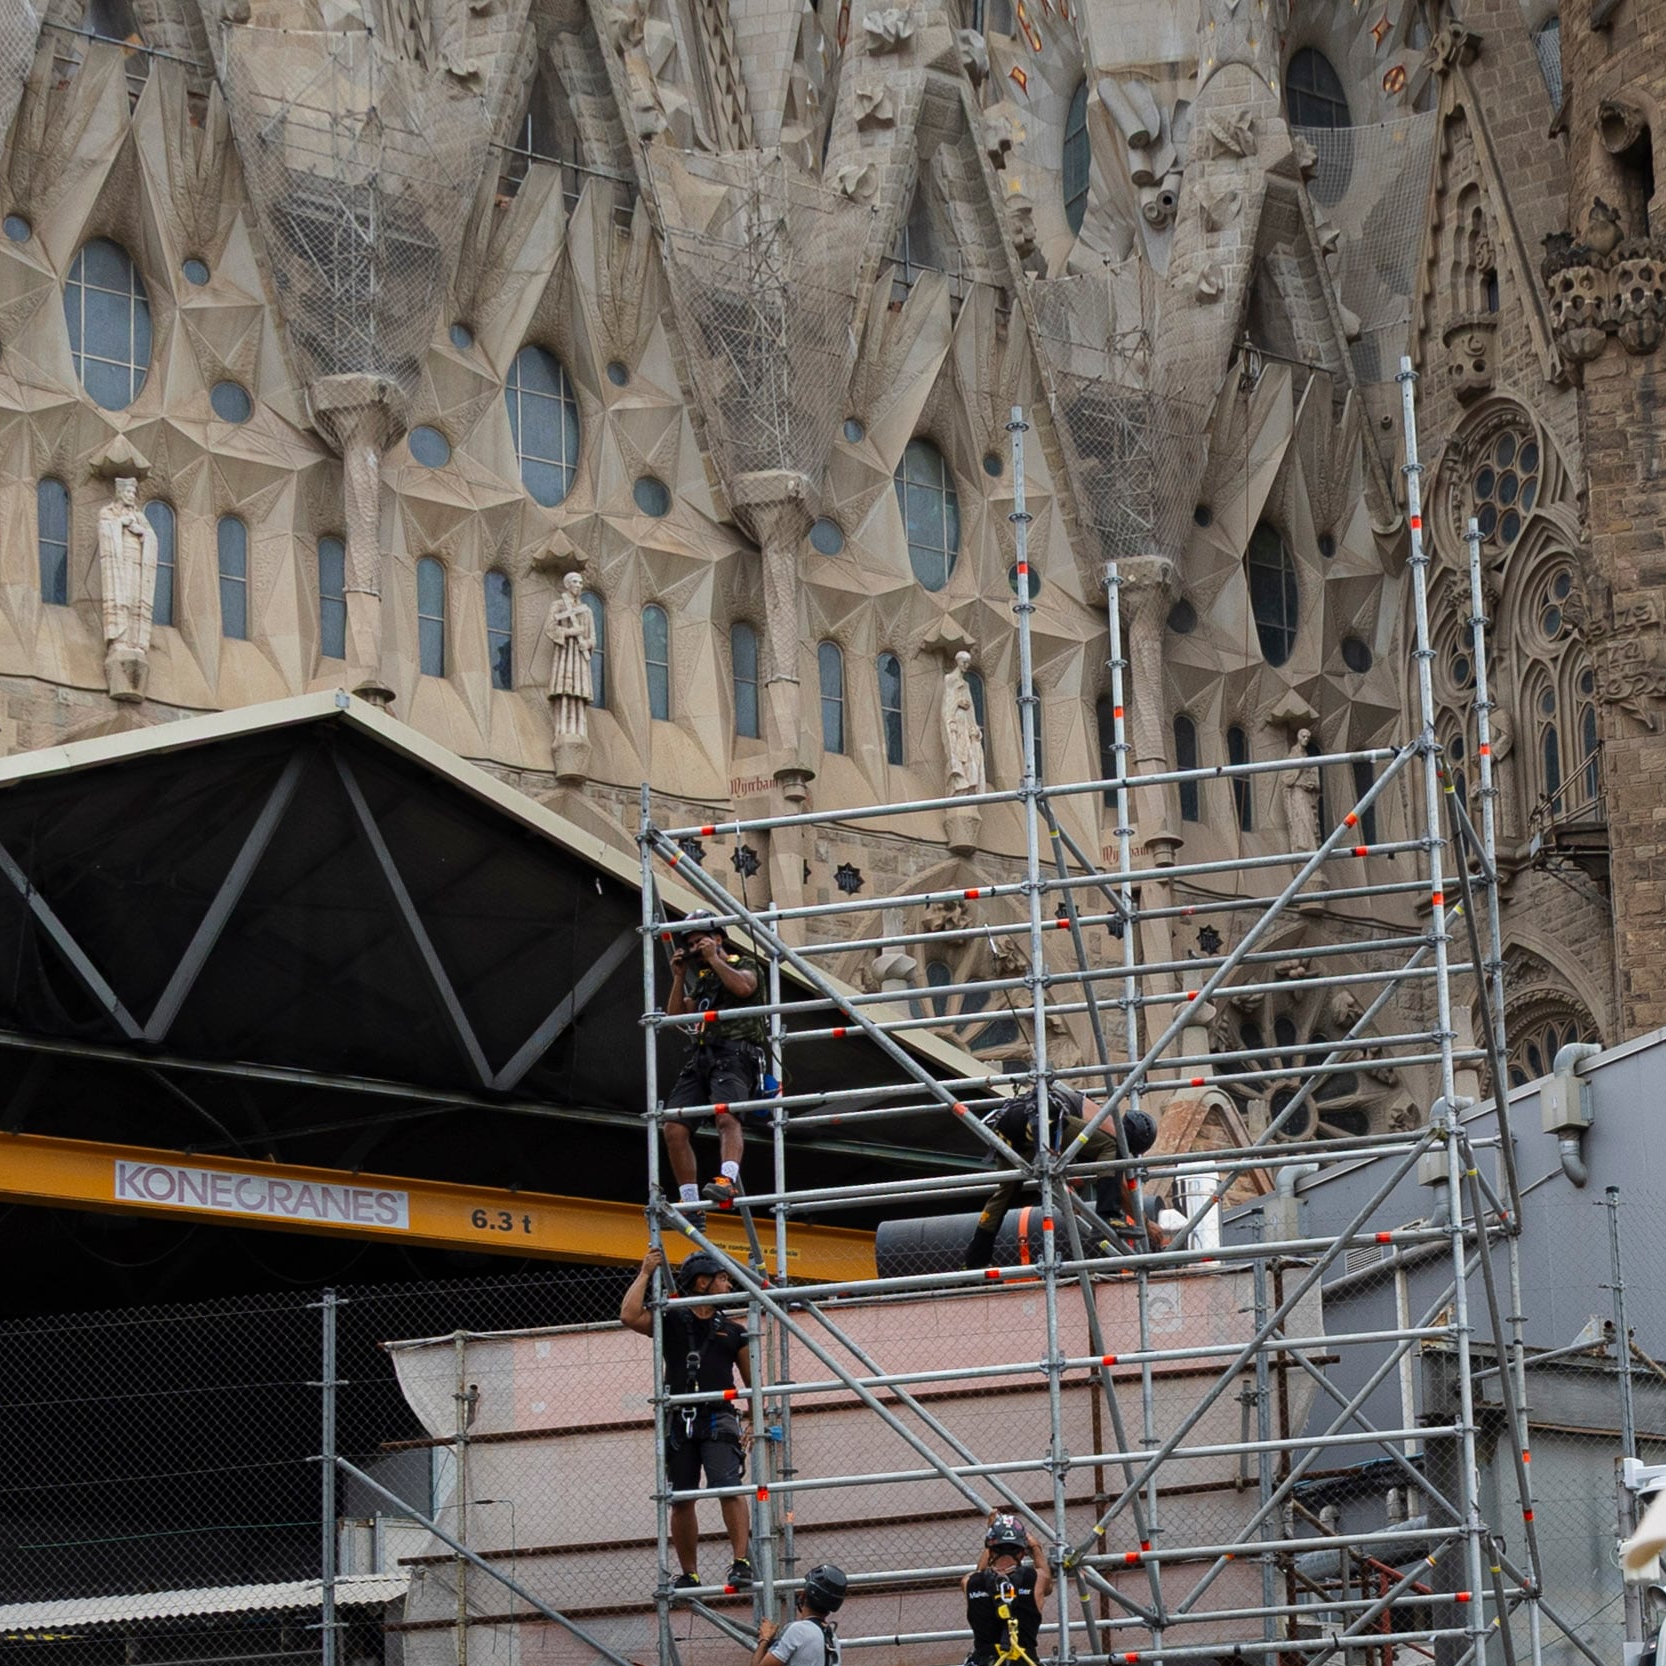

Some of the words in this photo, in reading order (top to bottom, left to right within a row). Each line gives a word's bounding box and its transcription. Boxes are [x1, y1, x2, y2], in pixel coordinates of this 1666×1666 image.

[119, 1164, 399, 1225] KONECRANES
[471, 1208, 514, 1232] 6.3
[522, 1213, 533, 1234] t
